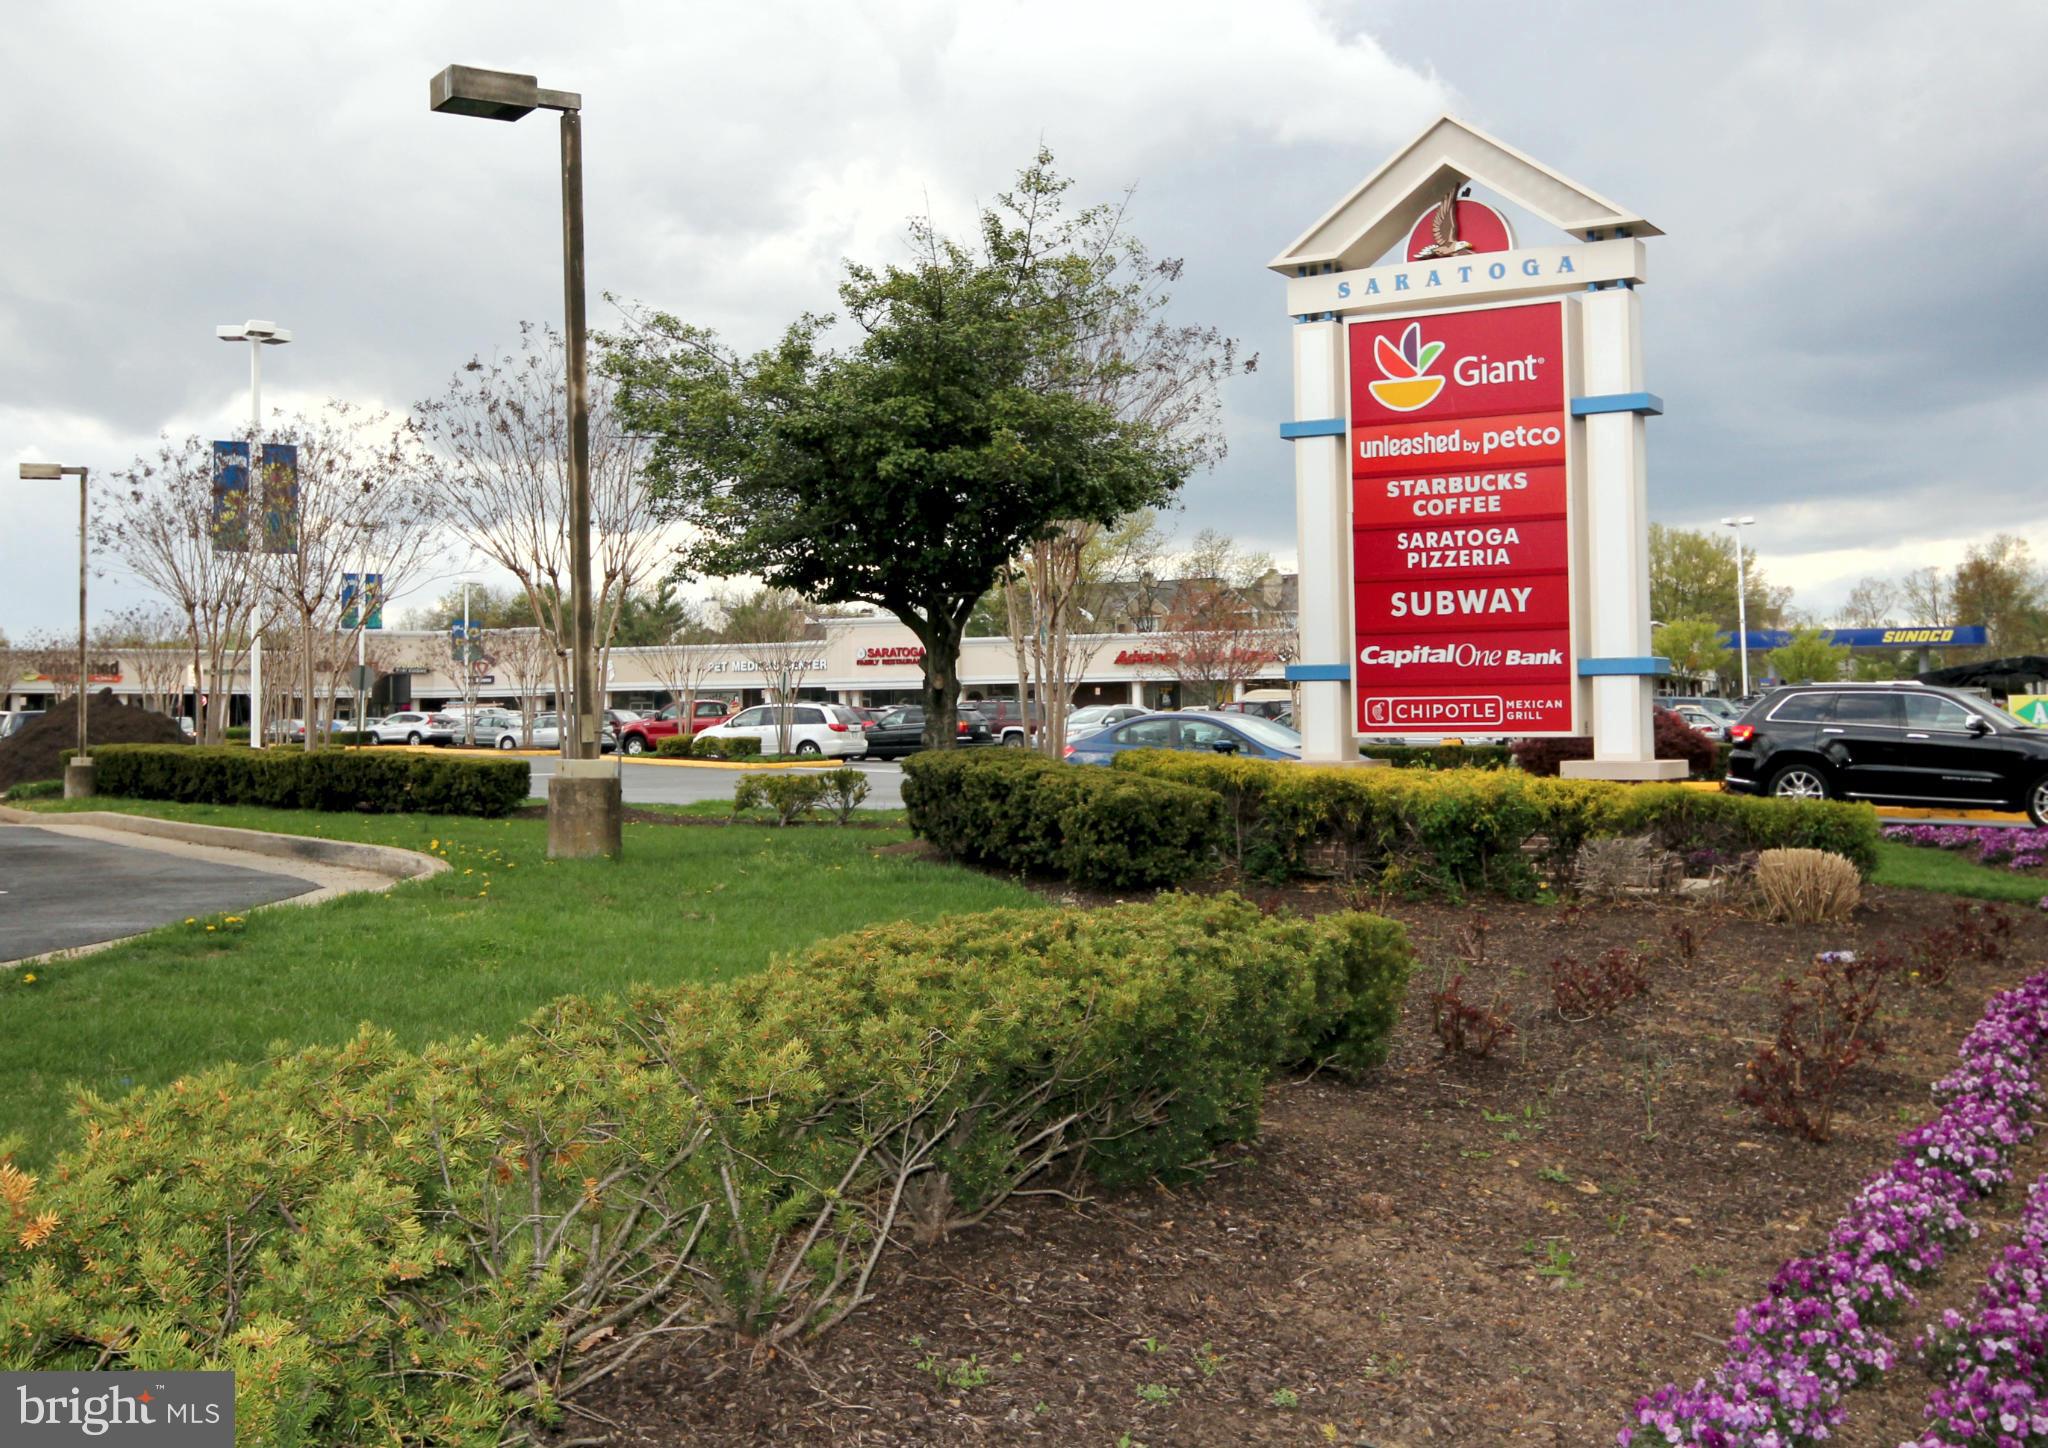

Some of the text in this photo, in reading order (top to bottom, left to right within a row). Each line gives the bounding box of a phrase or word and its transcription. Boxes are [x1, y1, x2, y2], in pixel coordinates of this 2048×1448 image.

[1337, 255, 1575, 298] SARATOGA
[1453, 354, 1537, 387] Giant
[1359, 425, 1561, 459] unleashed by petco
[1386, 471, 1528, 499] STARBUCKS
[1412, 494, 1501, 517] COFFEE
[1397, 527, 1520, 551] SARATOGA
[1407, 547, 1511, 569] PIZZERIA
[1391, 586, 1533, 617] SUBWAY
[1882, 629, 1954, 643] SUNOCO
[867, 647, 925, 658] SARATOGA
[1505, 648, 1564, 667] Bank
[1396, 699, 1563, 719] CHIPOTLE MEXICAN
[1506, 711, 1542, 720] GRILL
